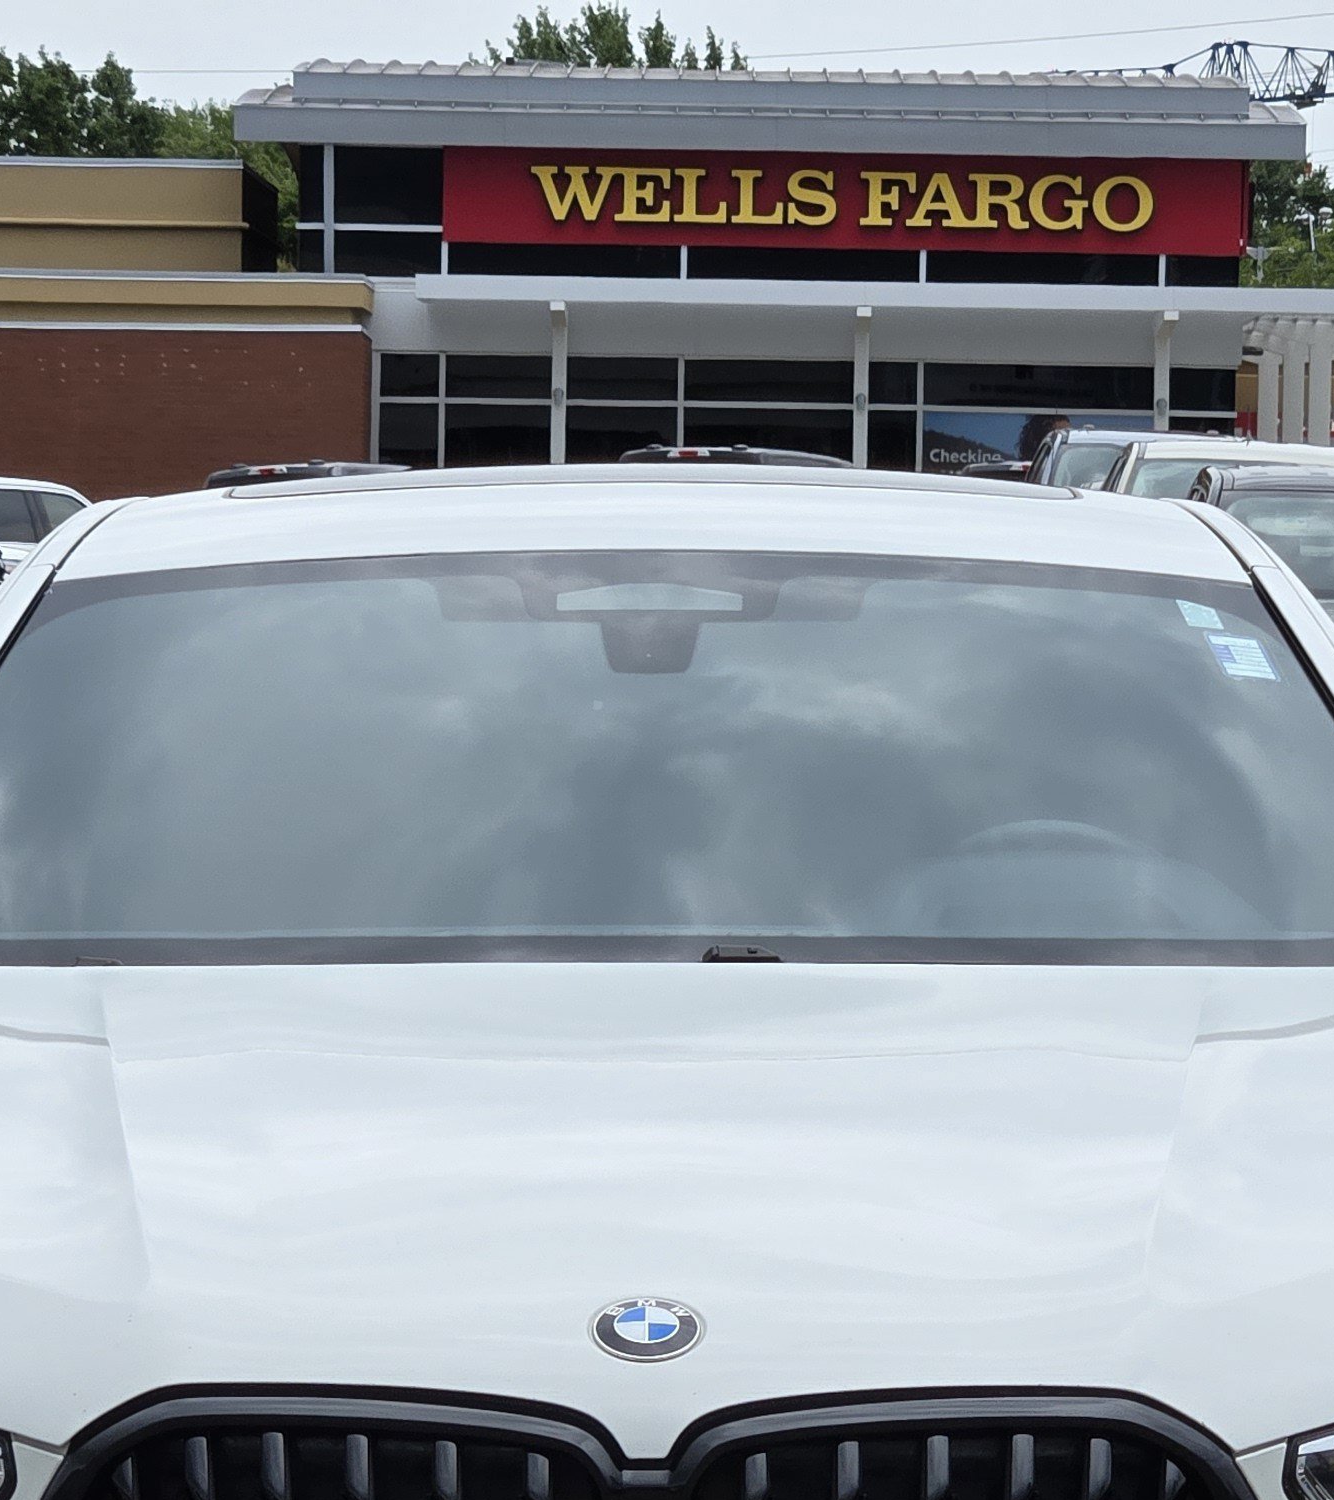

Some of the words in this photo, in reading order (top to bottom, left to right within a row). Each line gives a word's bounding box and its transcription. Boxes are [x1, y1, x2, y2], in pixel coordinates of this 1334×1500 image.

[530, 165, 838, 226] WELLS
[859, 171, 1154, 232] FARGO
[606, 1299, 691, 1316] BMW
